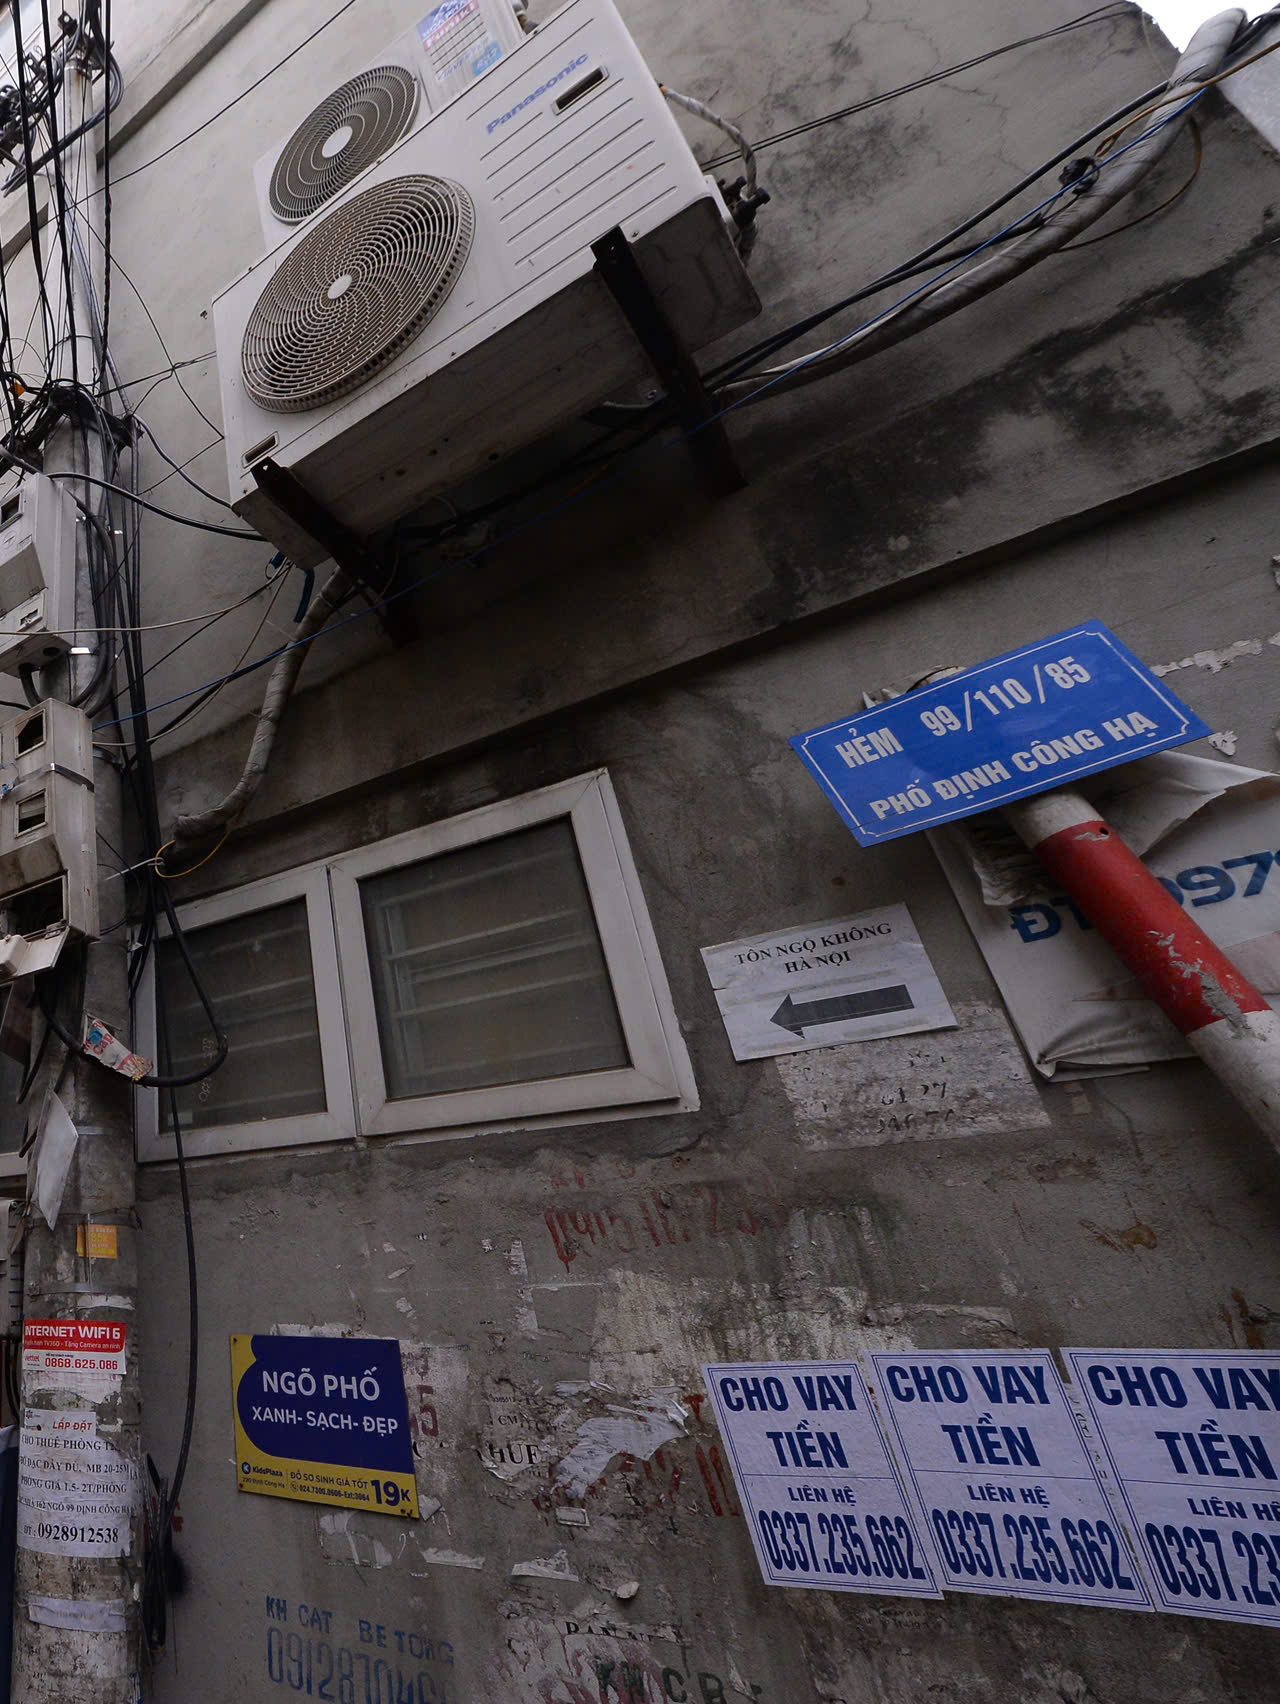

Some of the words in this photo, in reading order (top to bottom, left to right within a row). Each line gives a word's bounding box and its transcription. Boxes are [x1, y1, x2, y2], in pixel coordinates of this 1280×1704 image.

[486, 54, 589, 135] Panasonic
[835, 727, 904, 768] HẺM
[869, 778, 932, 820] PHỐ
[932, 759, 1013, 800] ĐỊNH
[1010, 728, 1105, 773] CÔNG
[1101, 710, 1159, 745] HẠ
[735, 950, 772, 965] TÔN
[821, 922, 893, 948] KHÔNG
[784, 959, 812, 974] HÀ
[816, 950, 852, 971] NỘI
[24, 1325, 76, 1337] NTERNET
[77, 1325, 110, 1339] WIFI
[112, 1328, 120, 1339] 6
[45, 1357, 118, 1370] 0868.625.086
[262, 1368, 317, 1397] NGÕ
[323, 1366, 380, 1402] PHỐ
[720, 1376, 789, 1412] CHO
[792, 1375, 858, 1411] VAY
[885, 1365, 969, 1404] CHO
[972, 1365, 1051, 1404] VAY
[1087, 1365, 1188, 1409] CHO
[1192, 1367, 1280, 1411] VAY
[52, 1417, 71, 1430] LẮP
[72, 1420, 93, 1433] ĐẶT
[362, 1415, 399, 1437] ĐẸP
[941, 1412, 1041, 1467] TIỀN
[36, 1435, 61, 1448] THUÊ
[63, 1437, 101, 1450] PHÒNG
[766, 1419, 849, 1468] TIỀN
[1155, 1419, 1278, 1480] TIỀN
[87, 1464, 102, 1473] MB
[252, 1466, 283, 1477] KidsPlaza
[315, 1475, 335, 1485] SINH
[336, 1477, 351, 1487] GIÁ
[352, 1478, 369, 1489] TỐT
[44, 1478, 61, 1490] GIÁ
[82, 1481, 127, 1493] 2T/PHÒNG
[787, 1484, 827, 1503] LIÊN
[832, 1486, 857, 1507] HỆ
[967, 1482, 1016, 1504] LIÊN
[1019, 1484, 1051, 1508] HỆ
[35, 1500, 46, 1509] 162
[98, 1503, 120, 1514] CÔNG
[1187, 1496, 1248, 1520] LIÊN
[38, 1522, 119, 1543] 0928912538
[758, 1509, 927, 1580] 0337.235.662
[931, 1508, 1136, 1590] 0337.235.662
[1145, 1523, 1280, 1606] 0337.23
[266, 1595, 288, 1622] KH
[298, 1603, 332, 1634] CAT
